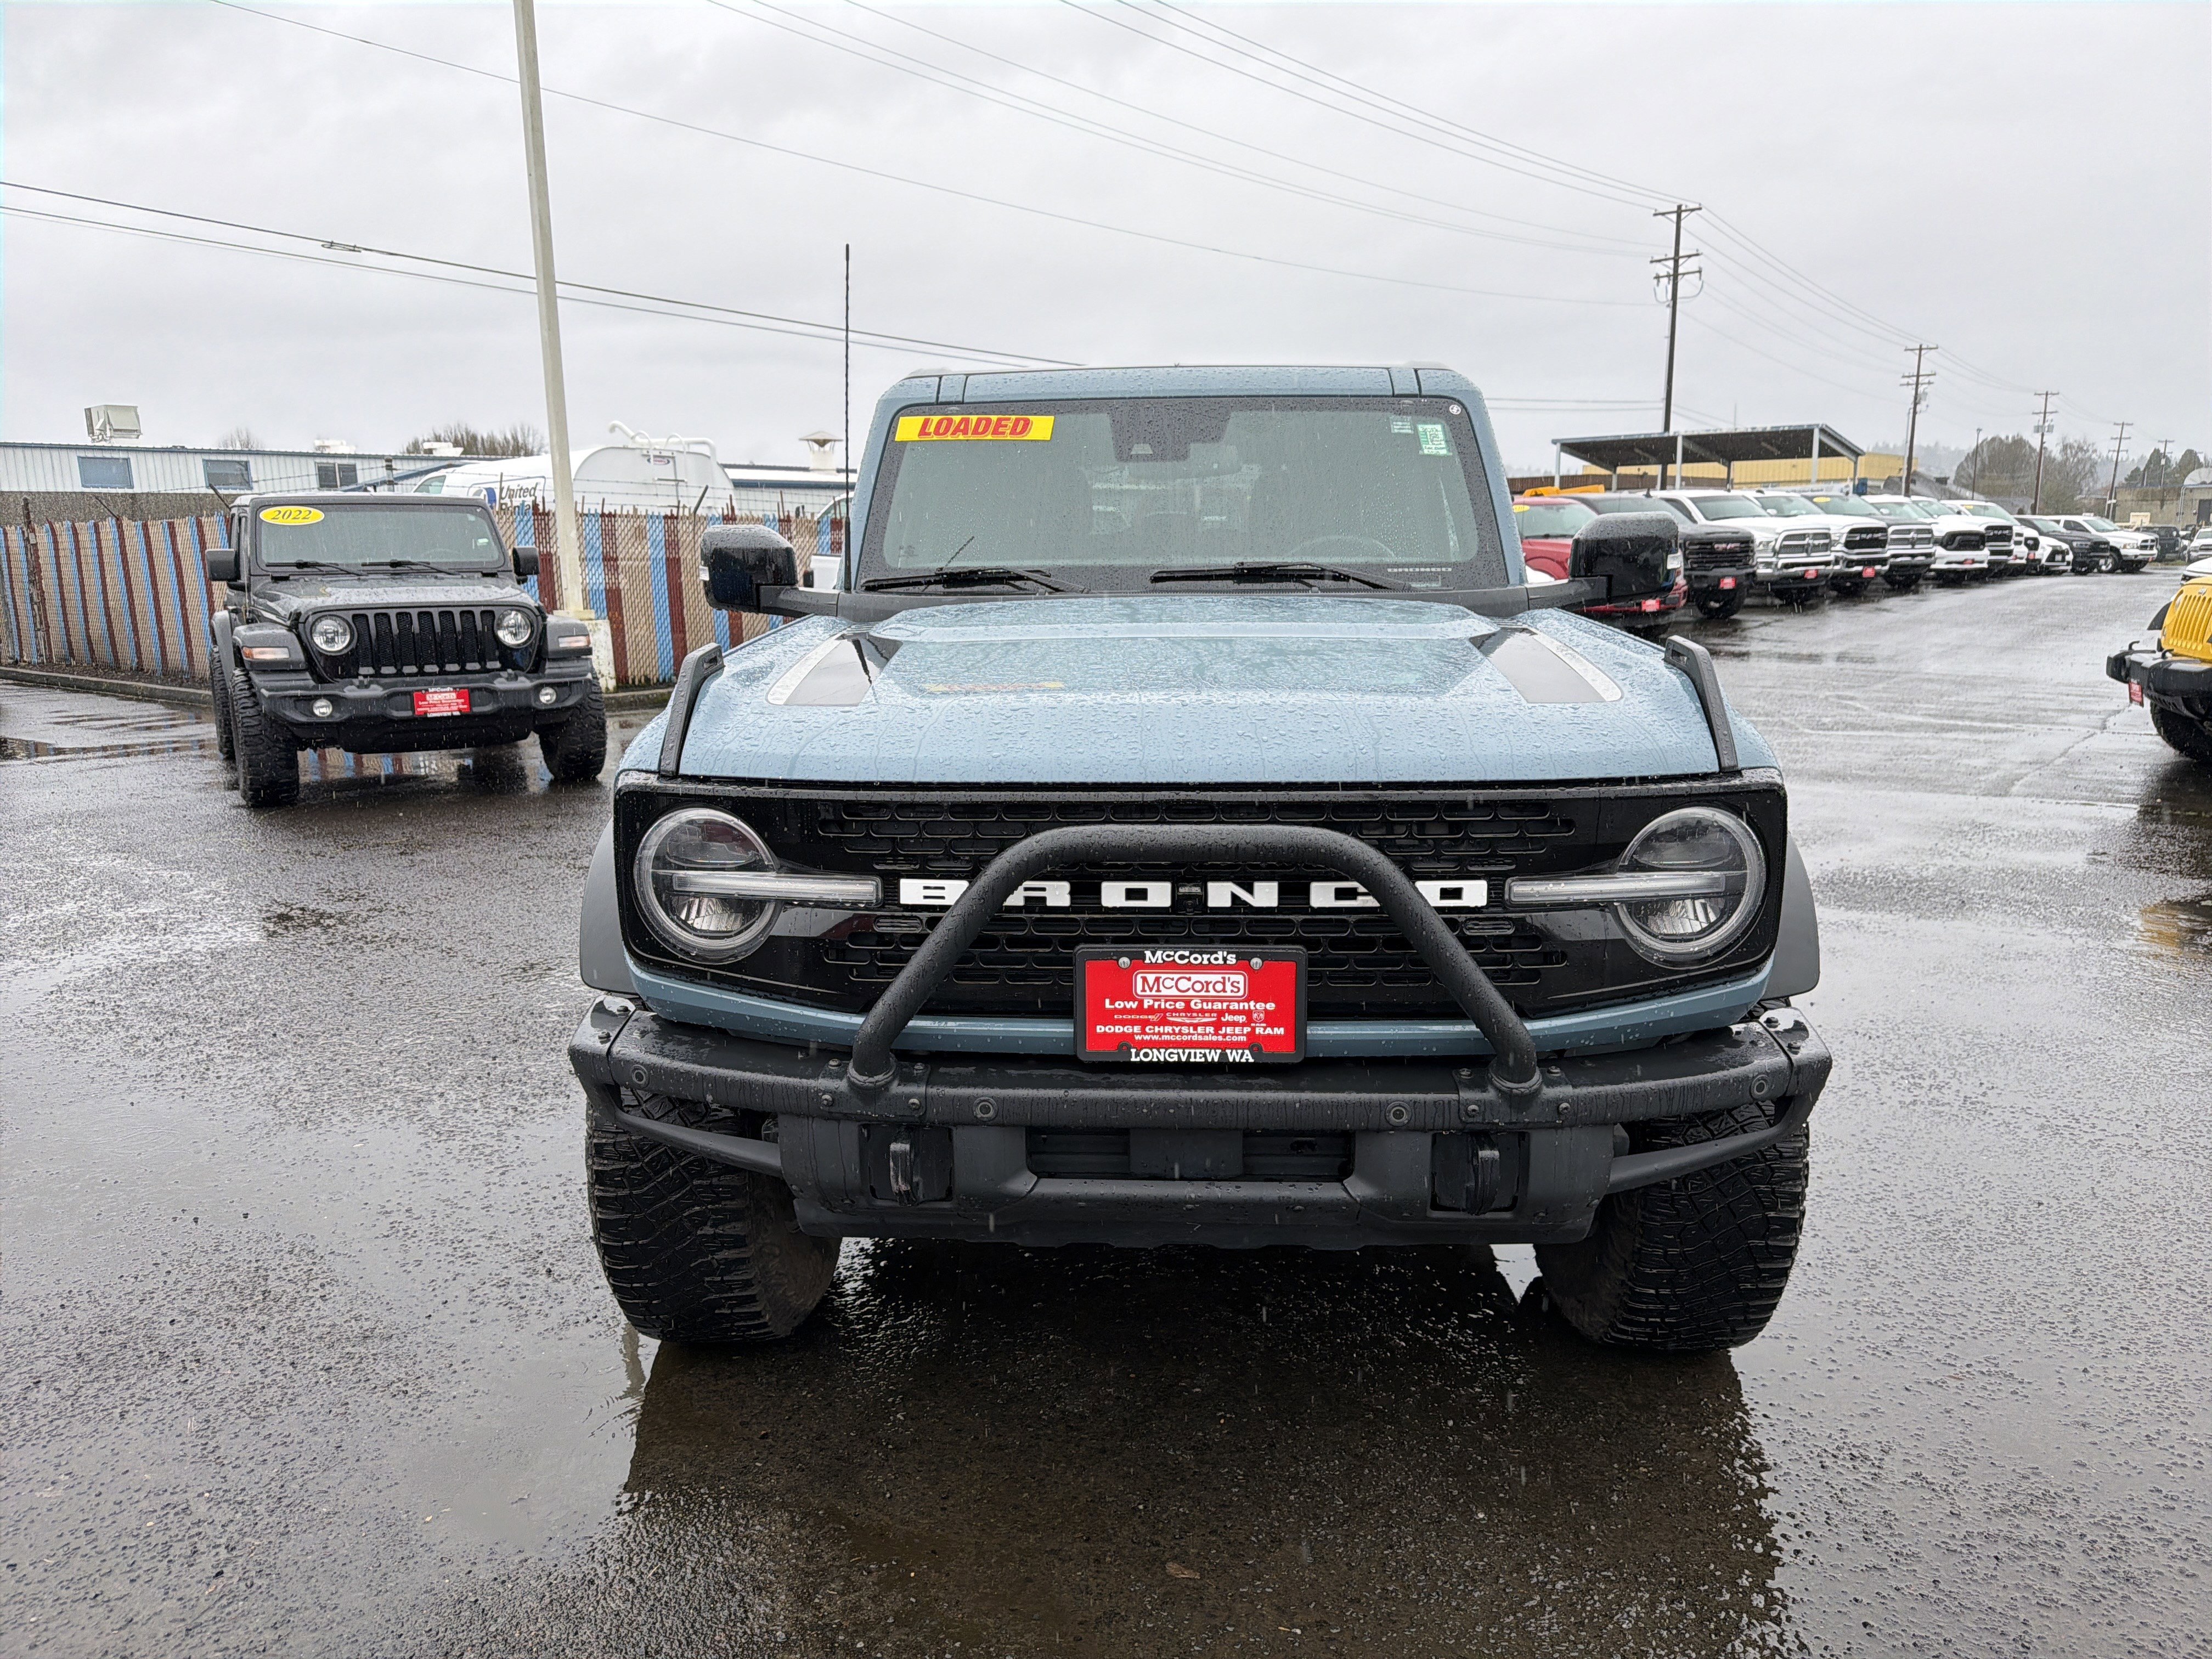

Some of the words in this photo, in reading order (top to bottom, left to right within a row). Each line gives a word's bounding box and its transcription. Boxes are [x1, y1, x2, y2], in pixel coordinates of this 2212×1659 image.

[918, 417, 1033, 438] LOADED
[500, 482, 538, 500] United
[271, 509, 312, 520] 2022
[900, 878, 1487, 907] BRONCO
[1144, 950, 1237, 964] McCord's
[1140, 976, 1241, 994] McCord's
[1105, 998, 1138, 1009] Low
[1143, 998, 1185, 1009] Price
[1190, 999, 1276, 1011] Guarantee
[1221, 1012, 1246, 1023] Jeep
[1096, 1025, 1142, 1033] DODGE
[1145, 1025, 1215, 1034] CHRYSLER
[1255, 1027, 1284, 1035] RAM
[1134, 1033, 1247, 1042] www.mccordsales.com
[1130, 1048, 1222, 1062] LONGVIEW
[1225, 1049, 1255, 1063] WA
